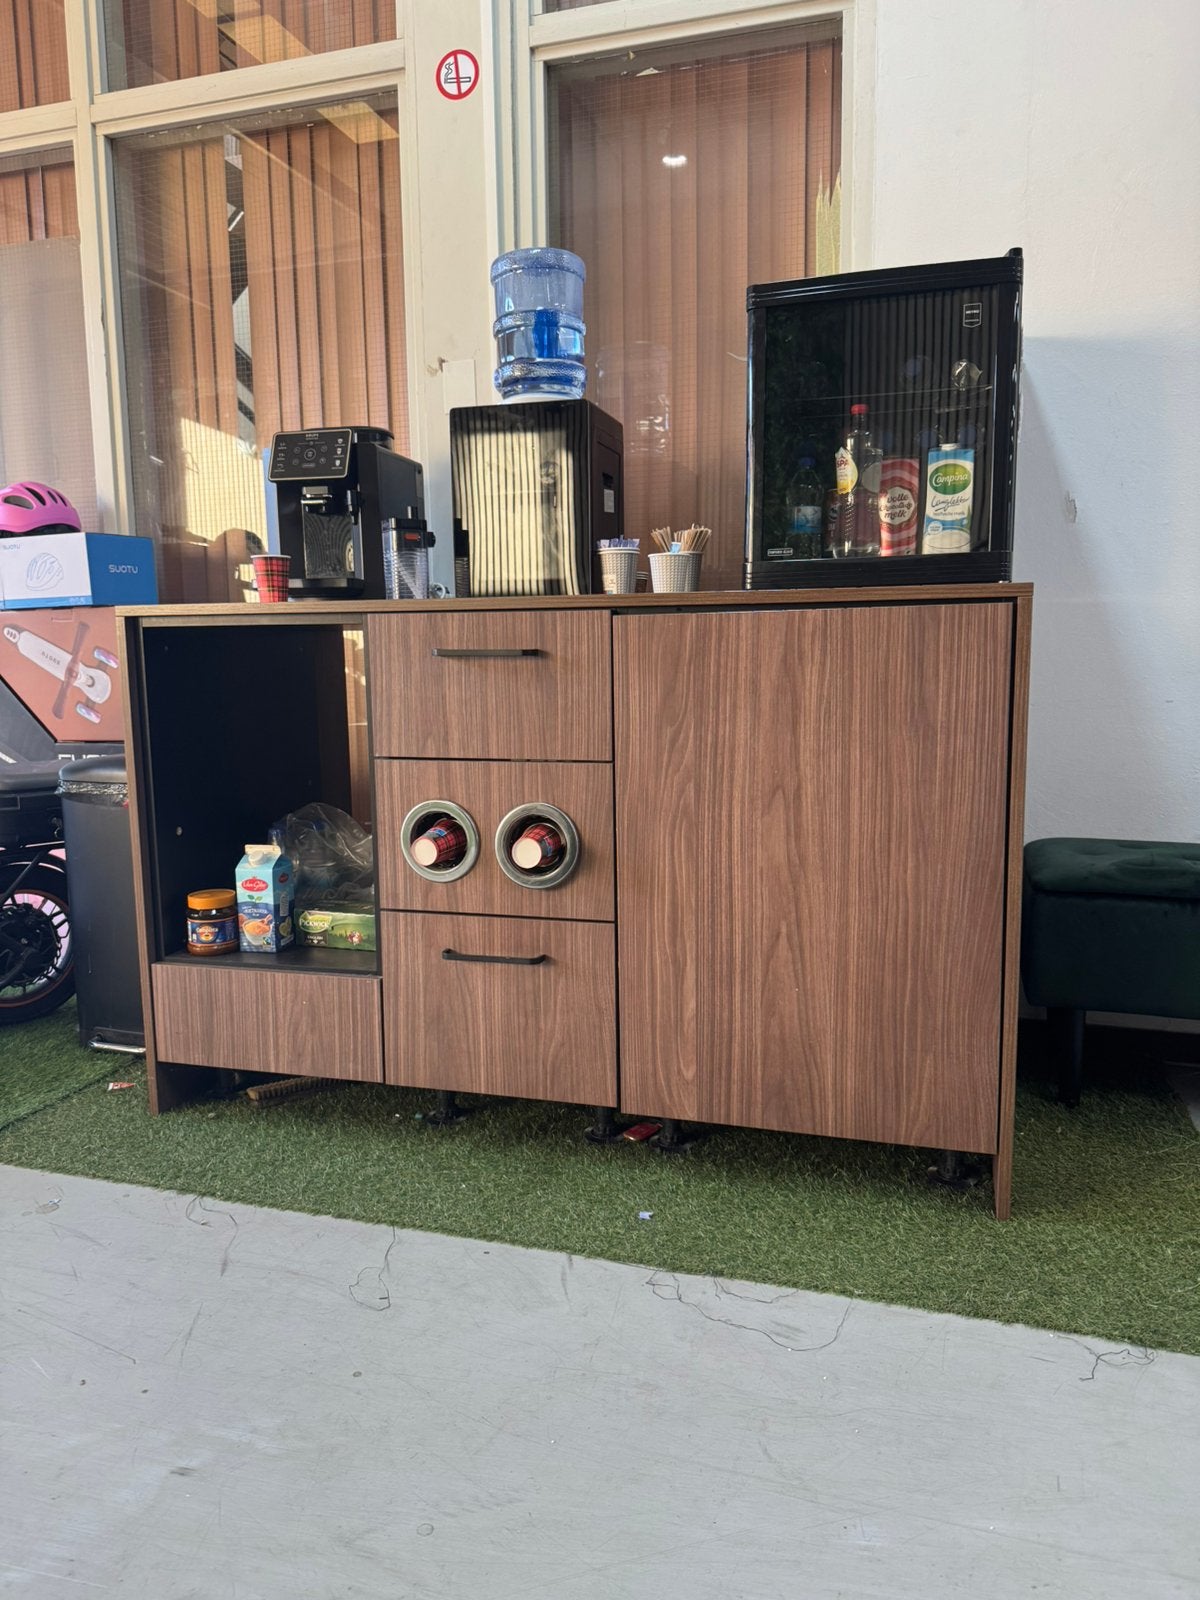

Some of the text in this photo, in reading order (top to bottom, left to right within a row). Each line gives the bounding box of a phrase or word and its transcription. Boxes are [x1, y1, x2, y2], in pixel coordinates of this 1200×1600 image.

[932, 472, 968, 487] Campina
[884, 510, 907, 520] melk
[108, 564, 139, 574] SUOTU
